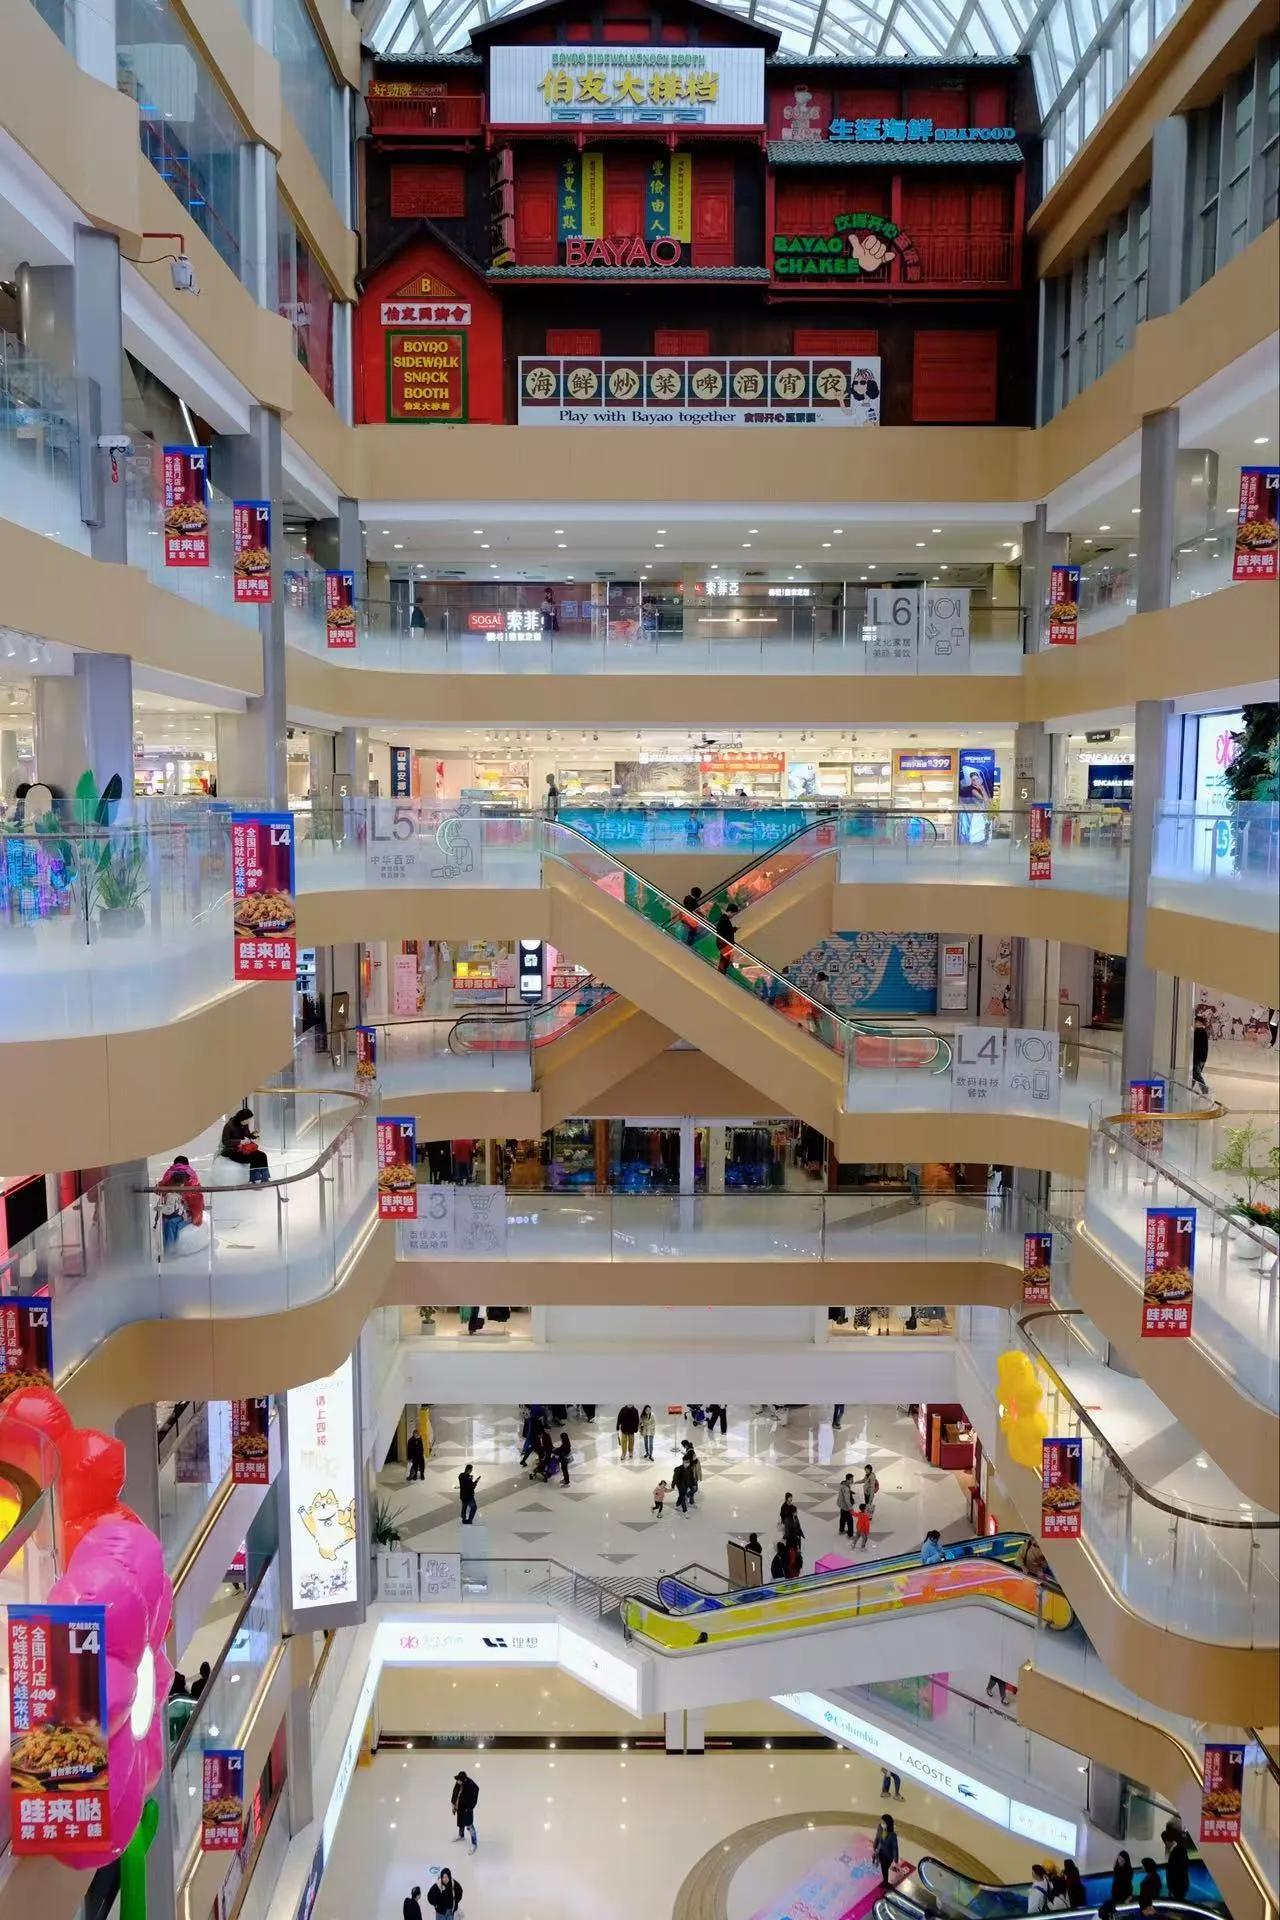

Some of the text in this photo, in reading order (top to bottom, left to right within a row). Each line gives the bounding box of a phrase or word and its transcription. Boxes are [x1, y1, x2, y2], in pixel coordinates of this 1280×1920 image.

[537, 70, 719, 105] 伯友大排档
[829, 118, 934, 141] 生猛海鲜
[935, 128, 1017, 141] SEAFOOD
[774, 236, 843, 253] BAYAO
[566, 237, 682, 267] BAYAO
[421, 278, 431, 293] B
[403, 341, 449, 354] BOYAO
[393, 356, 460, 370] SIDEWALK
[403, 371, 449, 385] SNACK
[403, 387, 450, 399] BOOTH
[559, 410, 736, 425] Play with Bayao together
[191, 459, 204, 470] L4
[1266, 478, 1280, 489] L4
[256, 510, 269, 521] L4
[343, 577, 353, 586] L4
[1069, 573, 1079, 582] L4
[873, 597, 911, 626] L6
[471, 615, 502, 625] SOGAL
[507, 610, 545, 631] 索菲
[339, 785, 347, 797] 5
[1020, 788, 1028, 799] 5
[371, 804, 415, 841] L5
[271, 830, 291, 845] L4
[371, 854, 415, 864] 中华百货
[240, 943, 291, 958] 蛙来哒
[338, 1004, 345, 1014] 4
[1064, 1015, 1072, 1026] 4
[957, 1035, 999, 1065] L4
[957, 1077, 999, 1087] 数码科技
[968, 1088, 987, 1098] 餐饮
[1151, 1089, 1163, 1098] L4
[401, 1126, 413, 1137] L4
[1177, 1221, 1193, 1233] L4
[29, 1312, 48, 1328] L4
[255, 1399, 267, 1409] L4
[1067, 1447, 1080, 1458] L4
[385, 1558, 411, 1579] L1
[69, 1631, 101, 1655] L4
[12, 1625, 30, 1730] 吃蛙就吃蛙来哒
[31, 1627, 56, 1717] 全国门店400家
[834, 1717, 880, 1748] Columbia
[228, 1759, 241, 1770] L4
[1229, 1752, 1243, 1764] L4
[899, 1752, 952, 1787] LACOSTE
[20, 1798, 102, 1822] 蛙来哒
